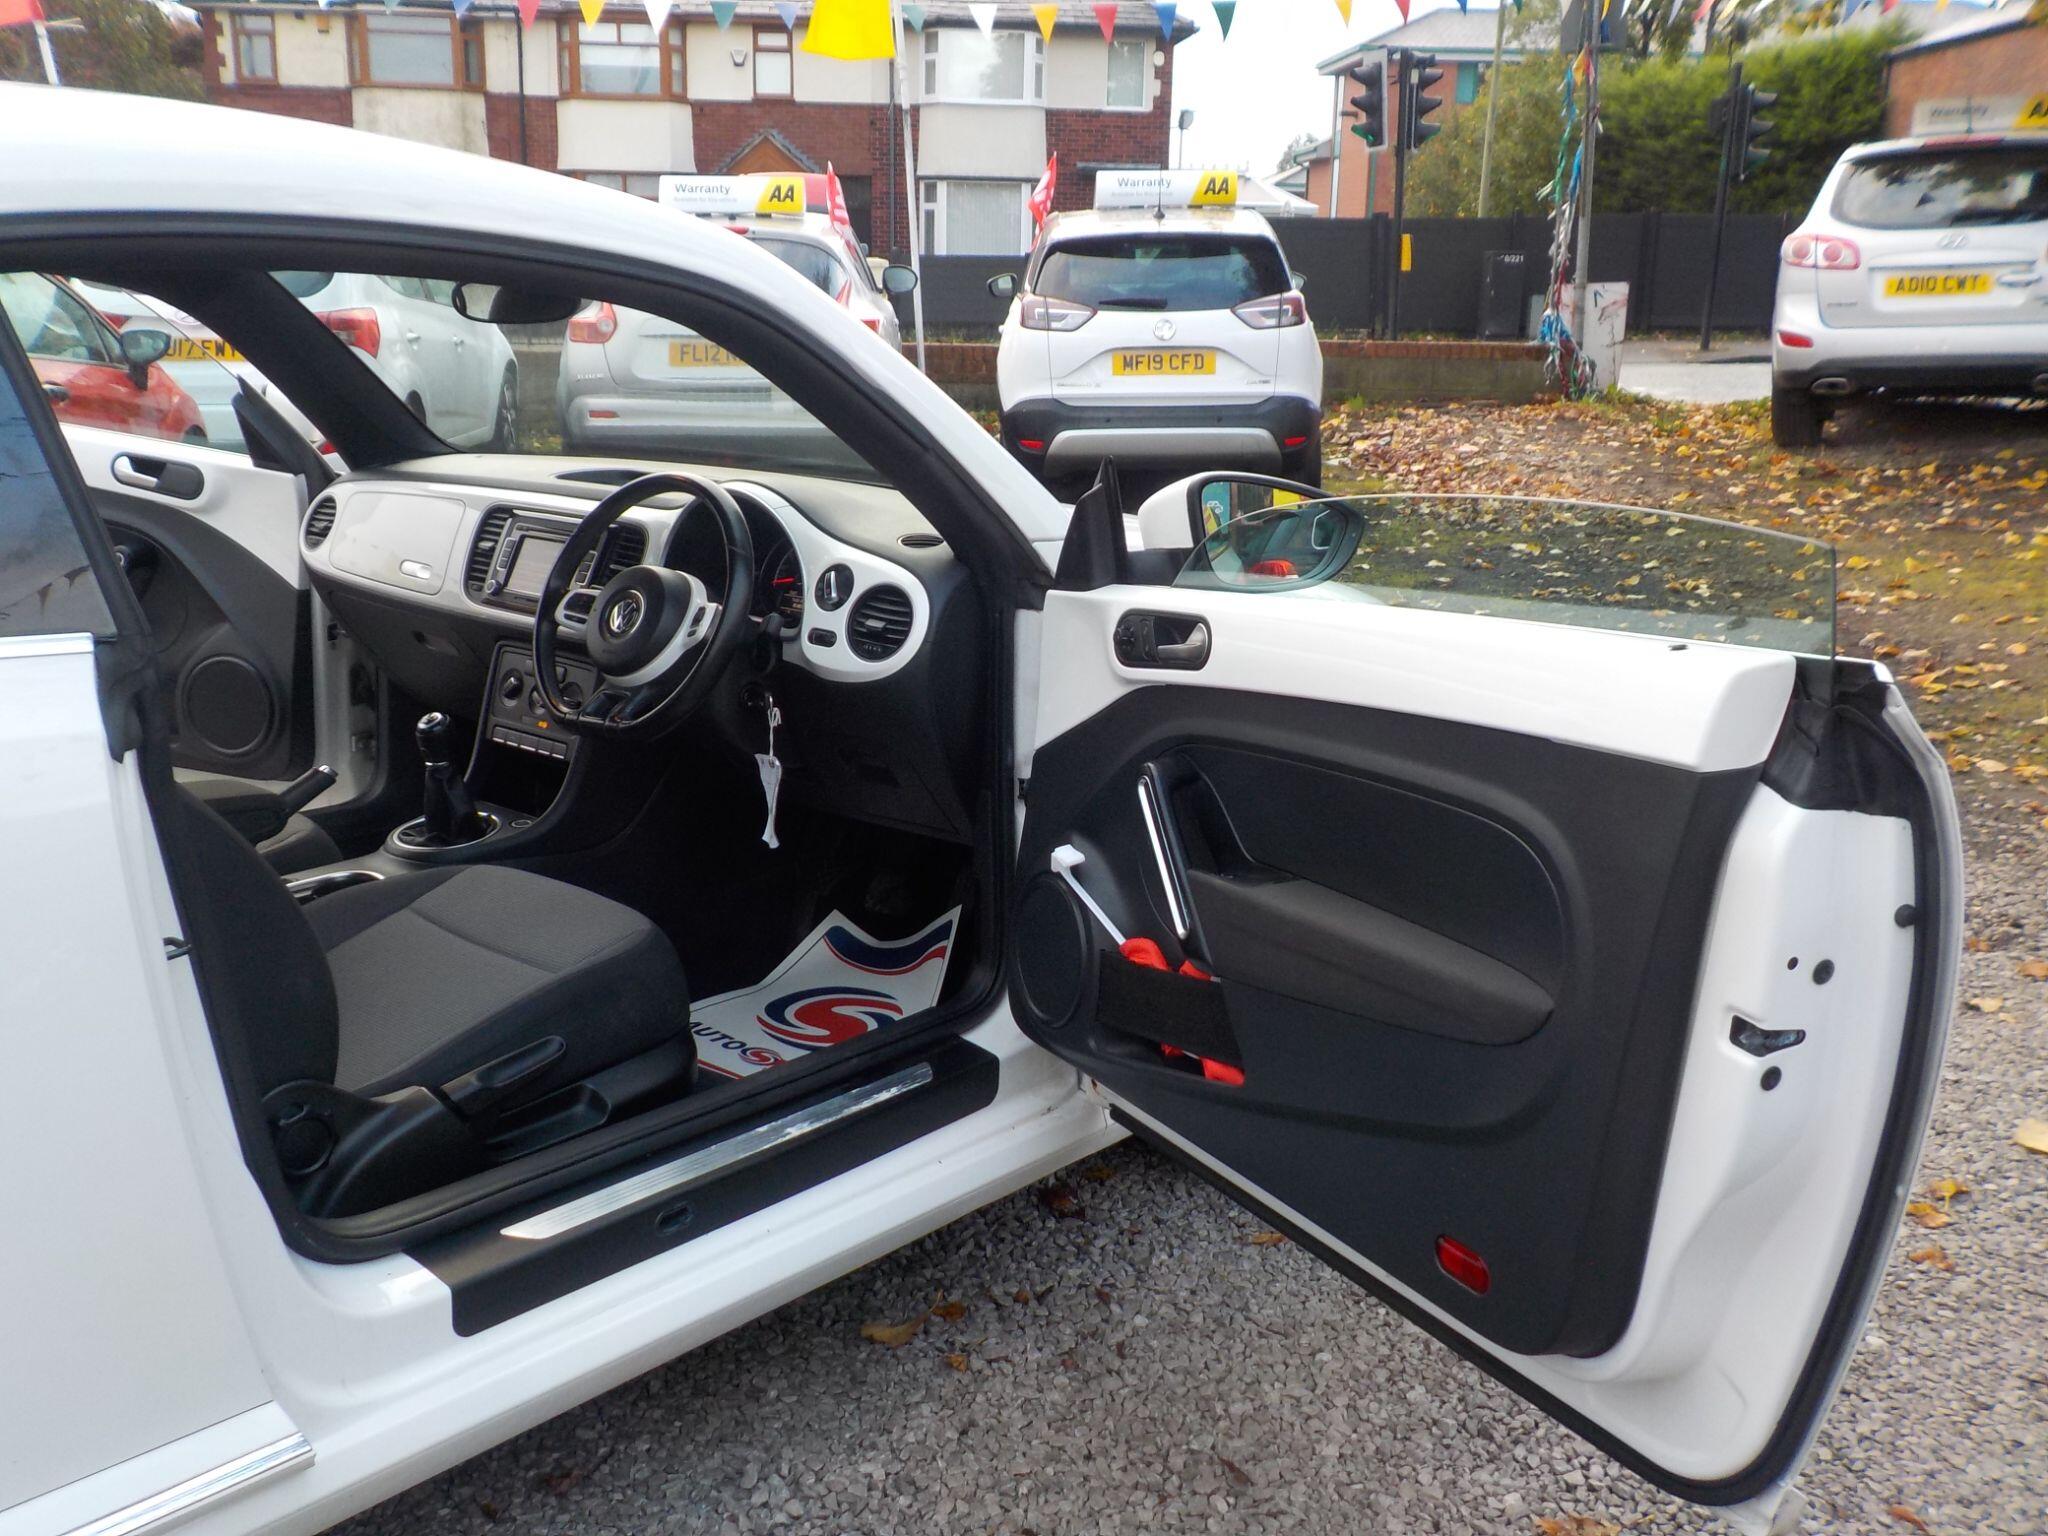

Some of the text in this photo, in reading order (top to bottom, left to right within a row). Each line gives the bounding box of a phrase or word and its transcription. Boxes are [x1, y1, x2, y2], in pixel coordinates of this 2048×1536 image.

[675, 183, 731, 195] Warranty
[1117, 177, 1172, 189] Warranty
[1203, 177, 1229, 196] AA
[768, 184, 795, 203] AA
[1123, 353, 1204, 371] MF19 CFD
